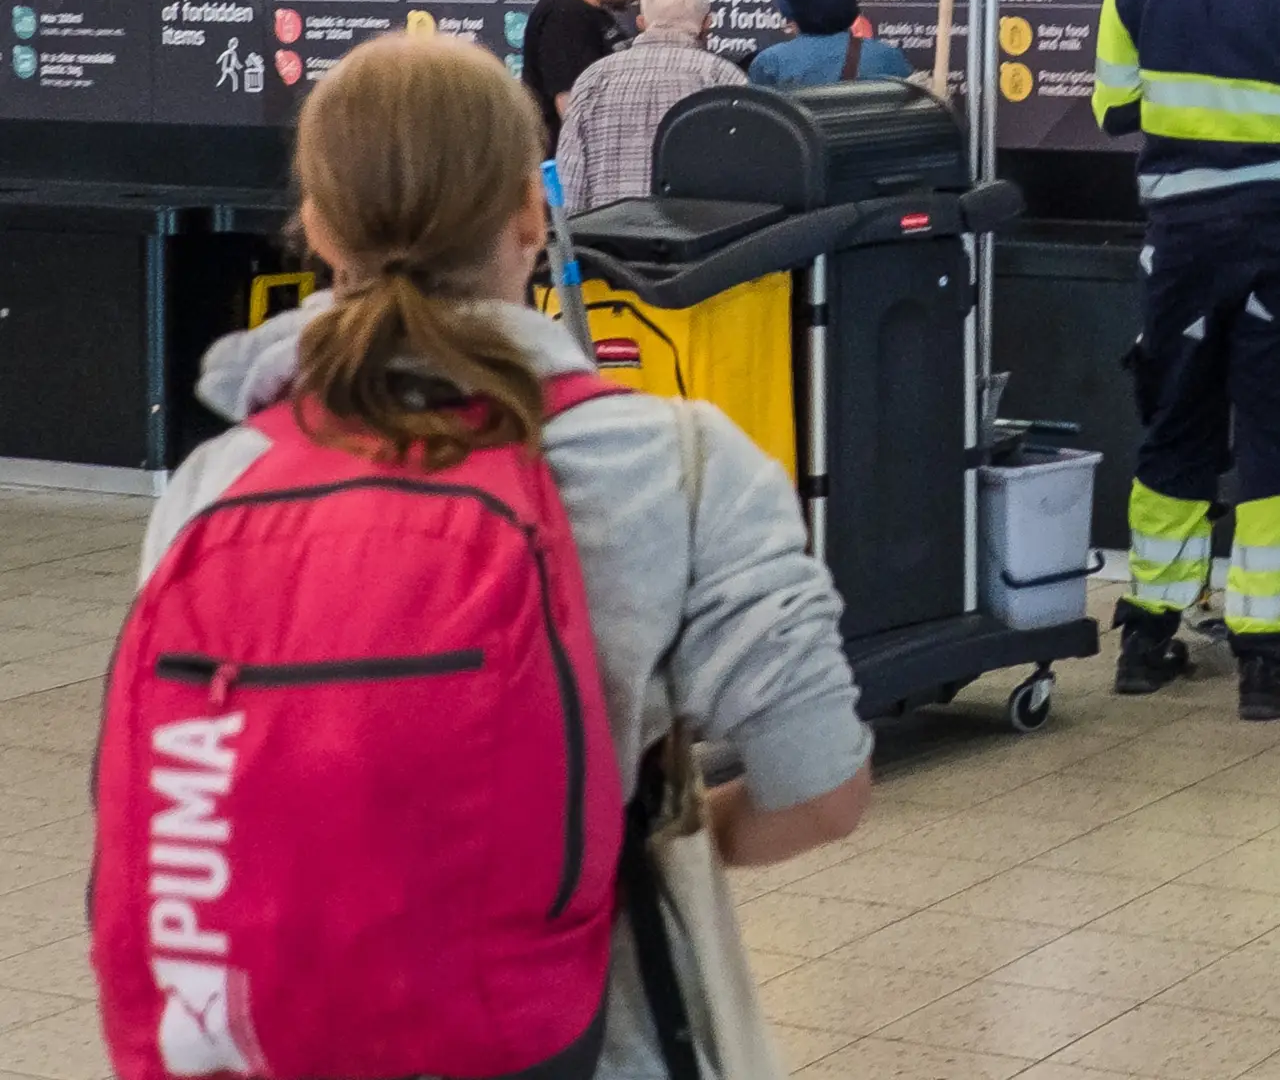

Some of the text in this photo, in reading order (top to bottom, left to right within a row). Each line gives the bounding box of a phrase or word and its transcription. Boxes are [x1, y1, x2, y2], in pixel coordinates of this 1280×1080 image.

[162, 2, 254, 22] of forbidden
[162, 25, 205, 46] items
[707, 33, 757, 54] items
[148, 711, 247, 956] PUMA
